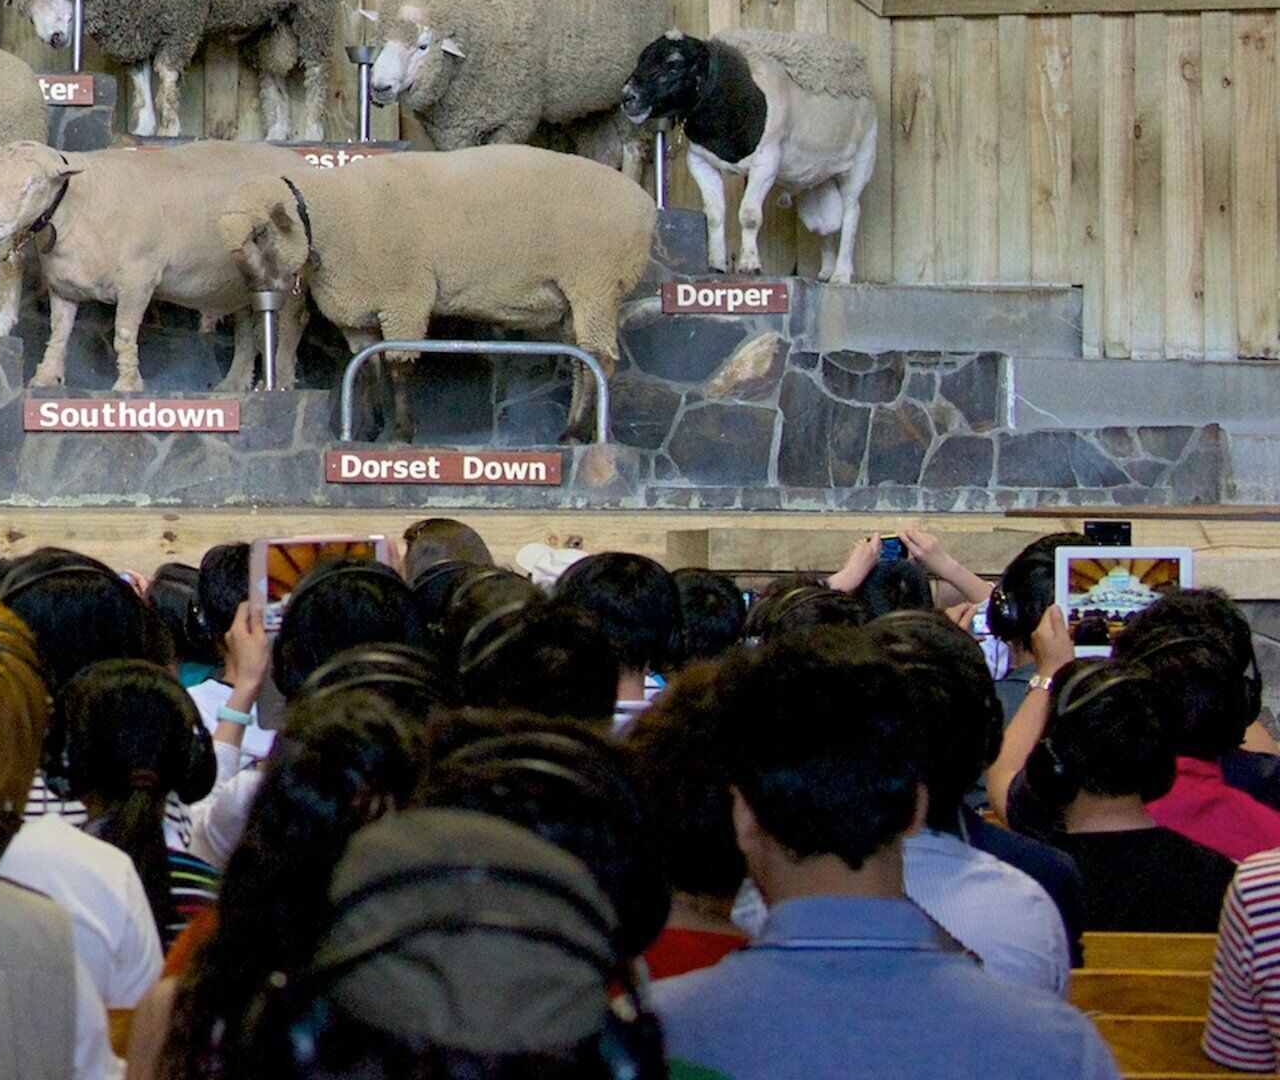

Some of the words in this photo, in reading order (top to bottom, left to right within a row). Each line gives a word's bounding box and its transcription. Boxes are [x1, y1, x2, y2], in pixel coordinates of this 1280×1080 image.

[677, 284, 773, 312] Dorper
[39, 401, 225, 428] Southdown
[340, 454, 441, 480] Dorset
[463, 455, 546, 481] Down
